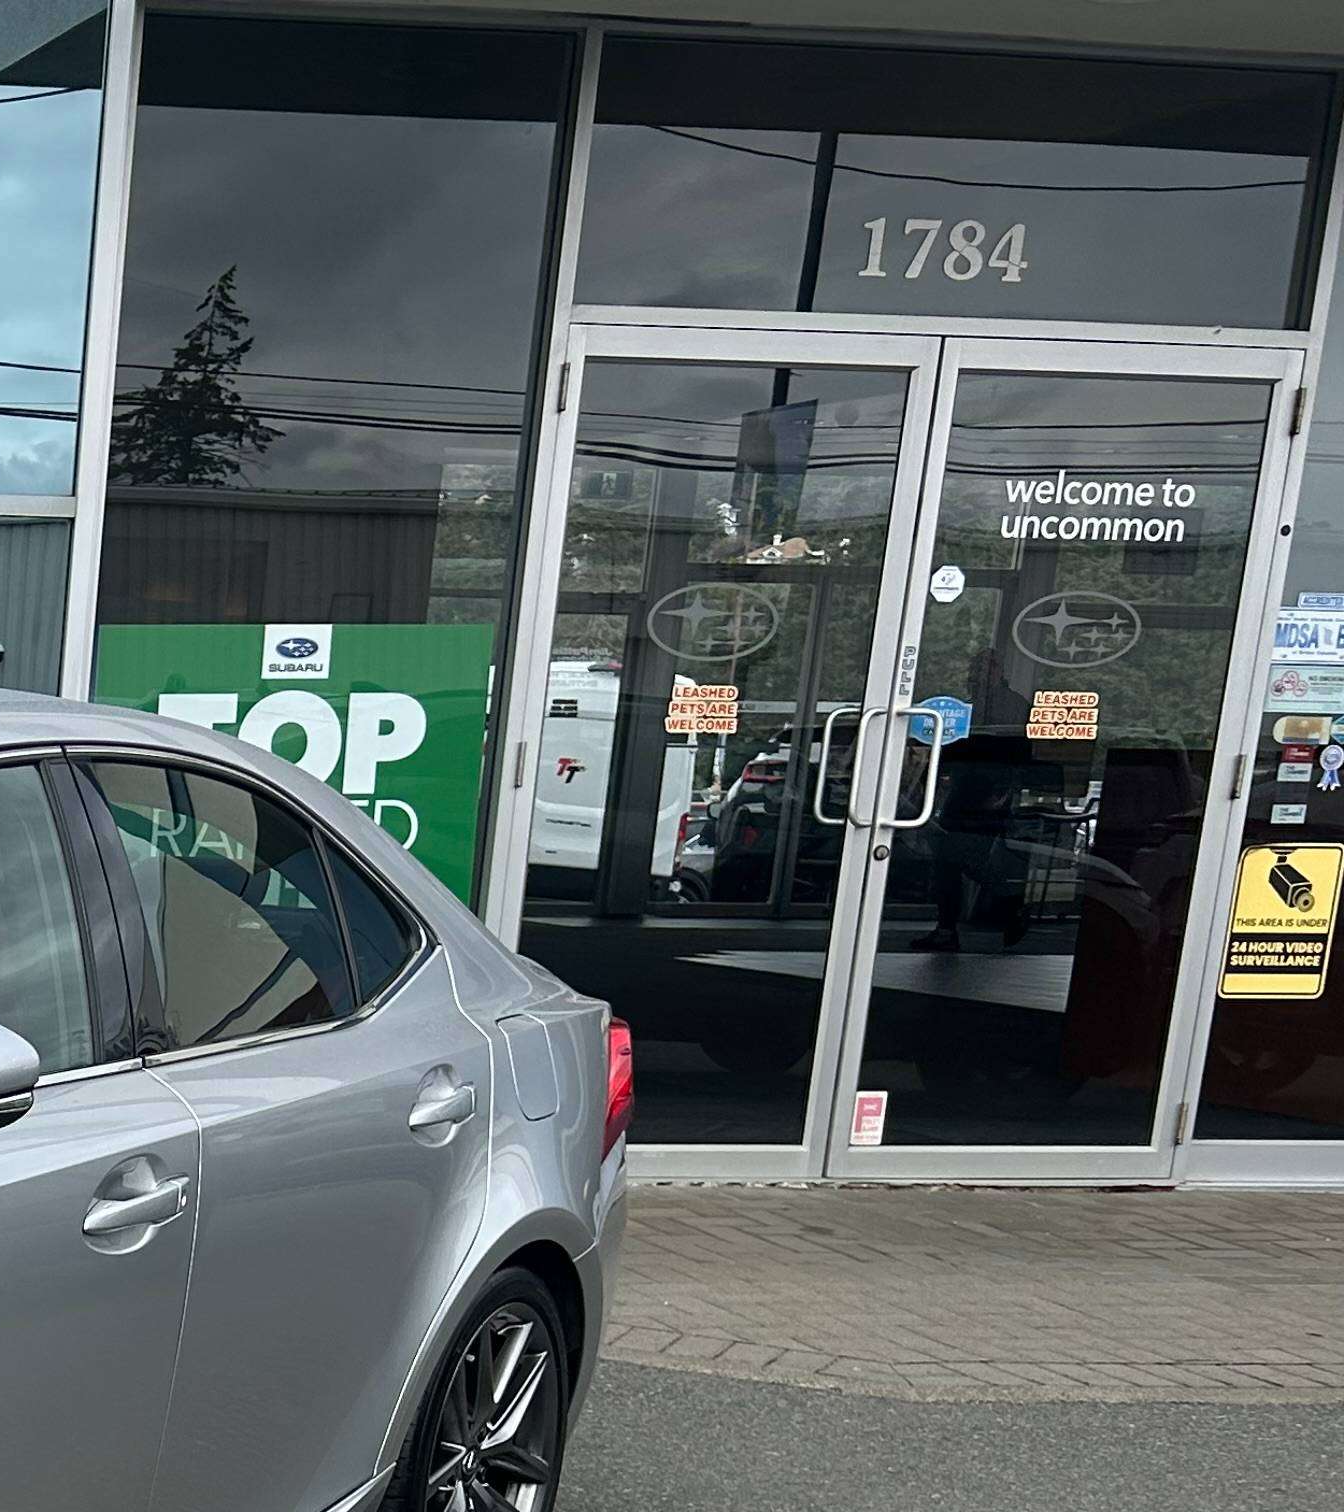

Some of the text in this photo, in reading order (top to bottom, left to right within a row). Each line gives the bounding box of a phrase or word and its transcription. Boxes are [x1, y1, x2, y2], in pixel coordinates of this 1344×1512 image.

[858, 216, 1029, 282] 1784
[1005, 469, 1196, 508] welcome to
[1000, 514, 1185, 543] uncommon
[267, 663, 324, 672] SUBARU
[674, 687, 736, 699] LEASHED
[1036, 693, 1096, 705] LEASHED
[671, 703, 735, 715] PETS ARE
[1032, 710, 1095, 721] PETS ARE
[667, 719, 735, 731] WELCOME
[1028, 726, 1095, 737] WELCOME
[1236, 918, 1328, 928] THIS AREA IS UNDER
[1230, 941, 1324, 953] 24 HOUR VIDEO
[1230, 955, 1321, 967] SURVEILLANCE
